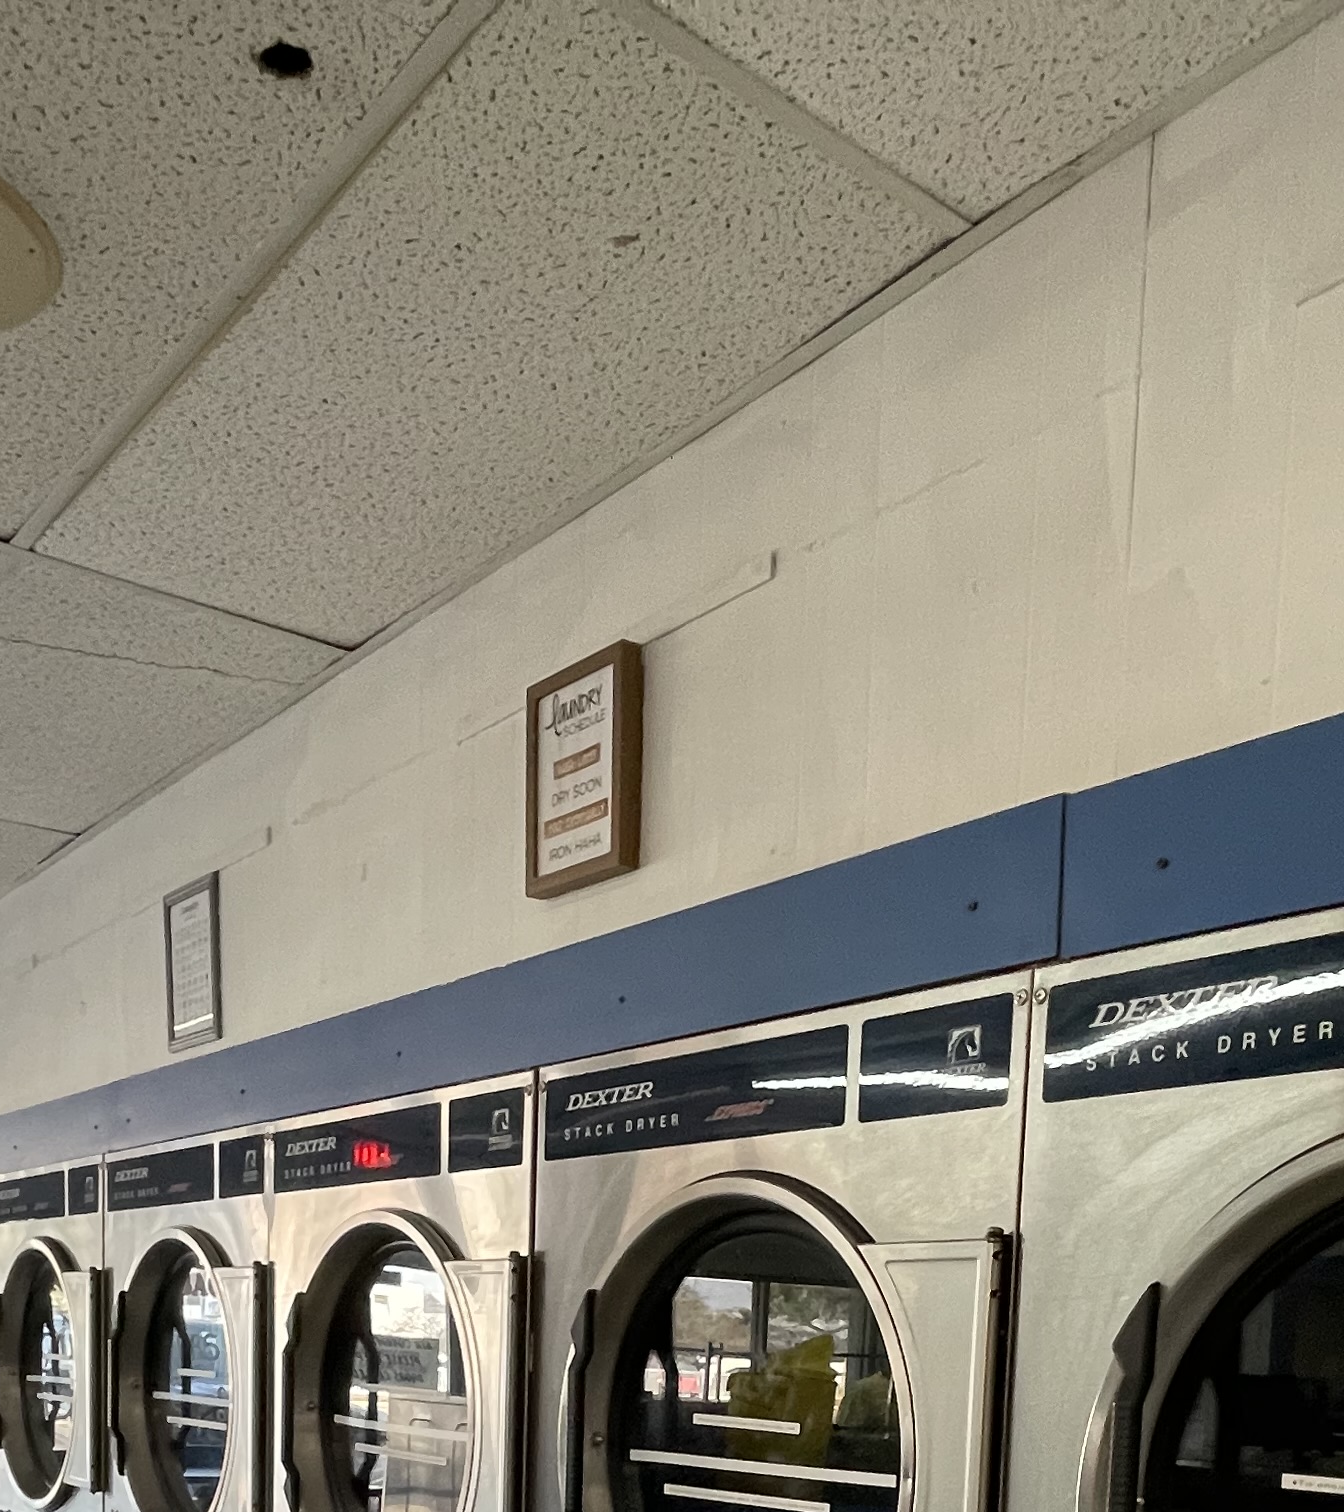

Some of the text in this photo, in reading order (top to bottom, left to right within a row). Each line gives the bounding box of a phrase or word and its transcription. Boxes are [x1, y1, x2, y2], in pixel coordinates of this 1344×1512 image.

[573, 776, 602, 799] SOON
[1088, 975, 1279, 1029] DEXTER
[1086, 1021, 1335, 1071] STACK DRYER
[565, 1081, 654, 1112] DEXTER
[564, 1113, 680, 1141] STACK DRYER
[285, 1136, 337, 1157] DEXTER
